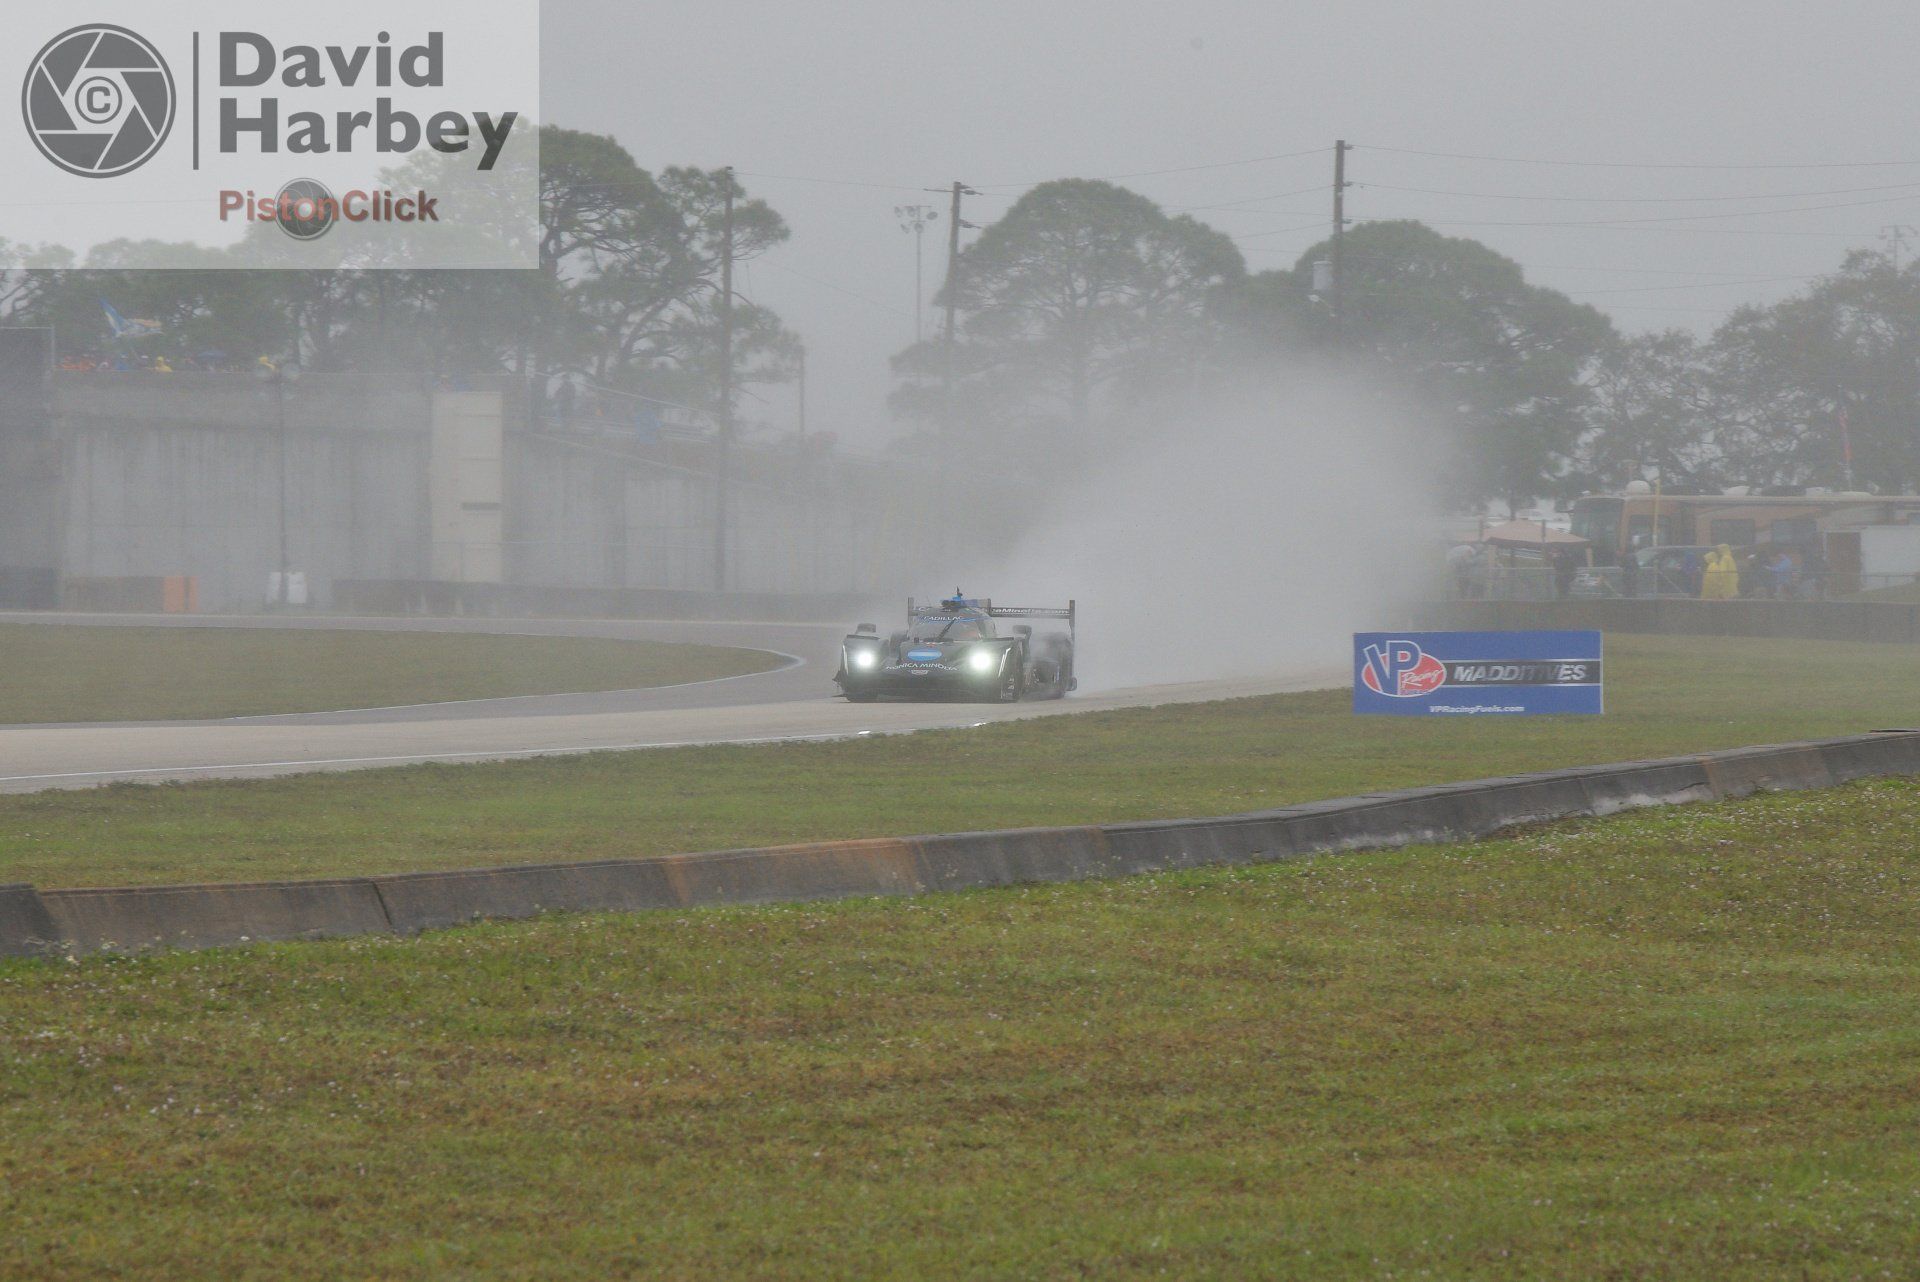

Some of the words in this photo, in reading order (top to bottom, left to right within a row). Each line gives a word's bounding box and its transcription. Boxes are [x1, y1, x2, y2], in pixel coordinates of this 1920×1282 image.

[919, 662, 958, 671] MINOLTA
[1362, 640, 1422, 697] VP
[1454, 664, 1587, 682] MADDITIVES
[1400, 668, 1444, 688] Racing
[1429, 704, 1526, 714] VPRacingFuels.com
